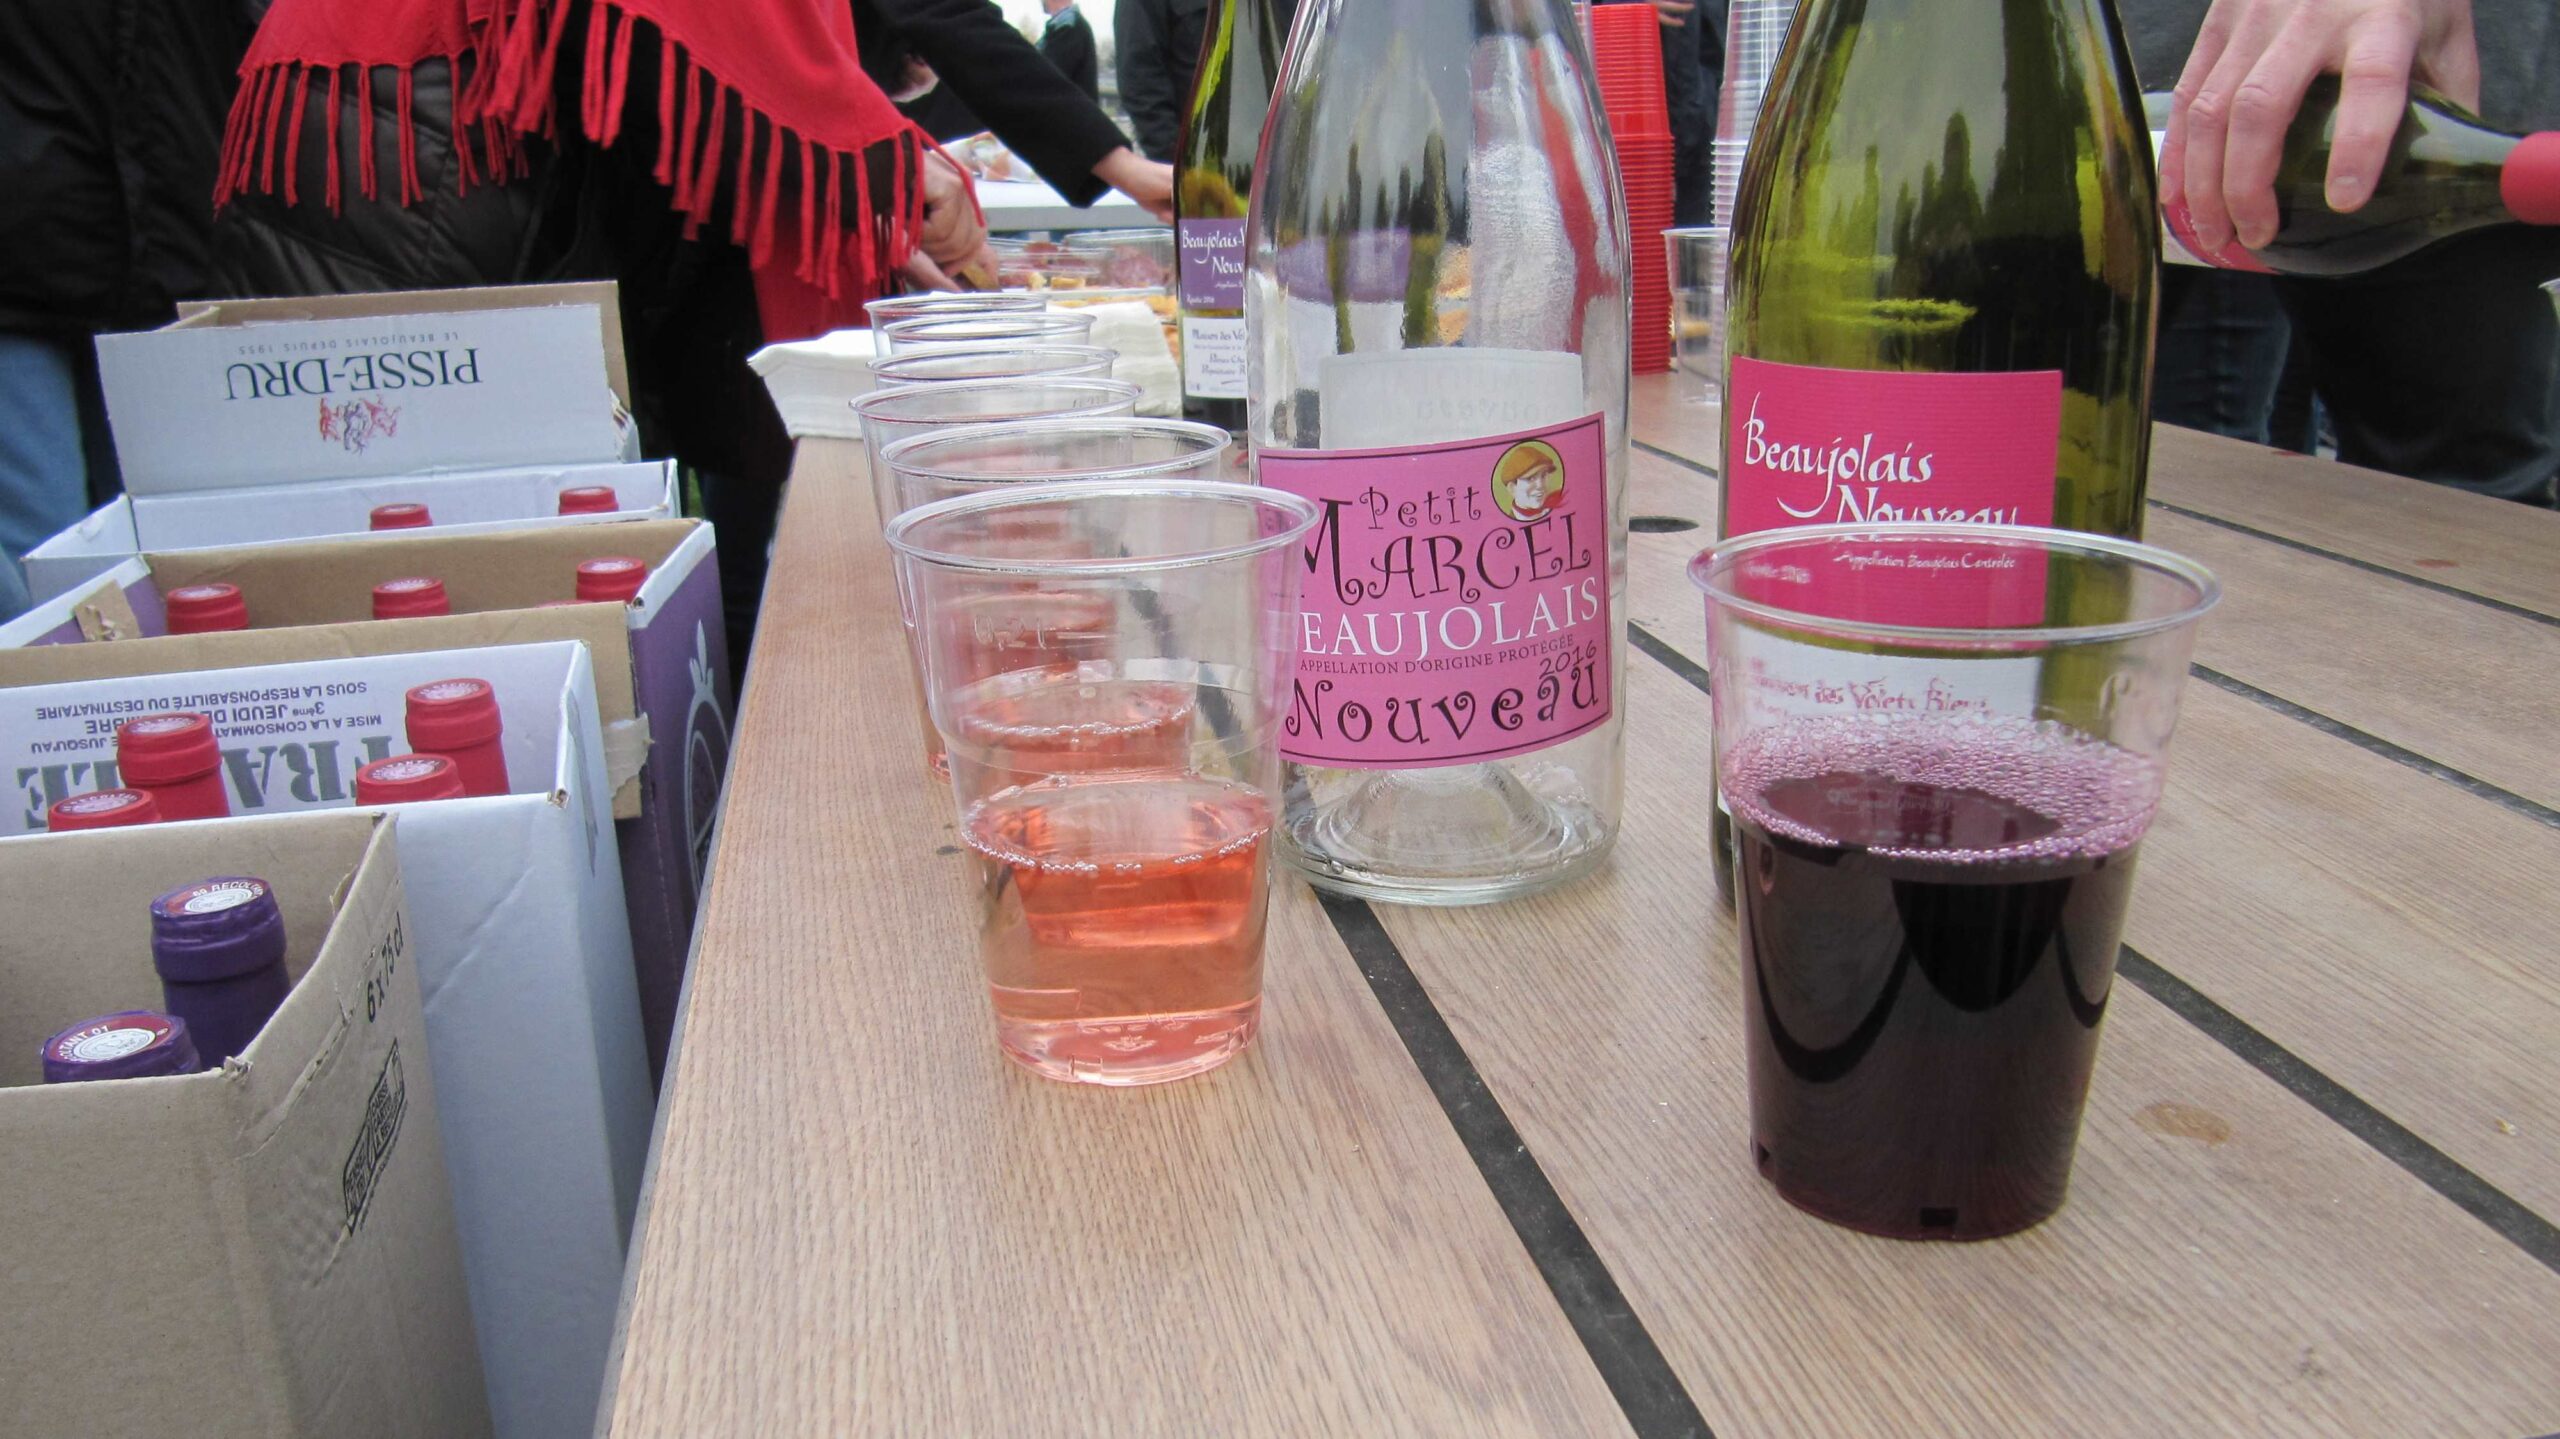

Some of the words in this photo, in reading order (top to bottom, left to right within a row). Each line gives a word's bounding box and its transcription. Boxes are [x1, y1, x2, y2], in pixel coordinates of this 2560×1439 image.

[283, 340, 337, 351] DEPUIS
[345, 334, 435, 349] BEAUJOLAIS
[445, 332, 459, 341] LE
[239, 345, 273, 355] 1955
[224, 347, 484, 401] PISSE-DRU
[1743, 392, 1934, 518] Beaujolais
[1359, 486, 1482, 530] Petit
[1303, 497, 1592, 606] MARCEL
[1300, 576, 1599, 662] EAUJOLAIS
[1300, 658, 1400, 675] APPELLATION
[1404, 653, 1494, 674] D'ORIGINE
[1538, 640, 1598, 680] 2016
[171, 686, 300, 710] RESPONSABILITÉ
[300, 685, 324, 698] LA
[326, 682, 368, 697] SOUS
[36, 699, 145, 720] DESTINATAIRE
[147, 697, 170, 709] DU
[231, 703, 289, 724] JEUDI
[310, 719, 332, 732] LA
[347, 713, 382, 729] MISE
[30, 735, 108, 755] JUSQU'AU
[16, 735, 393, 830] FRALE
[367, 980, 376, 1023] 6
[381, 932, 395, 987] 75
